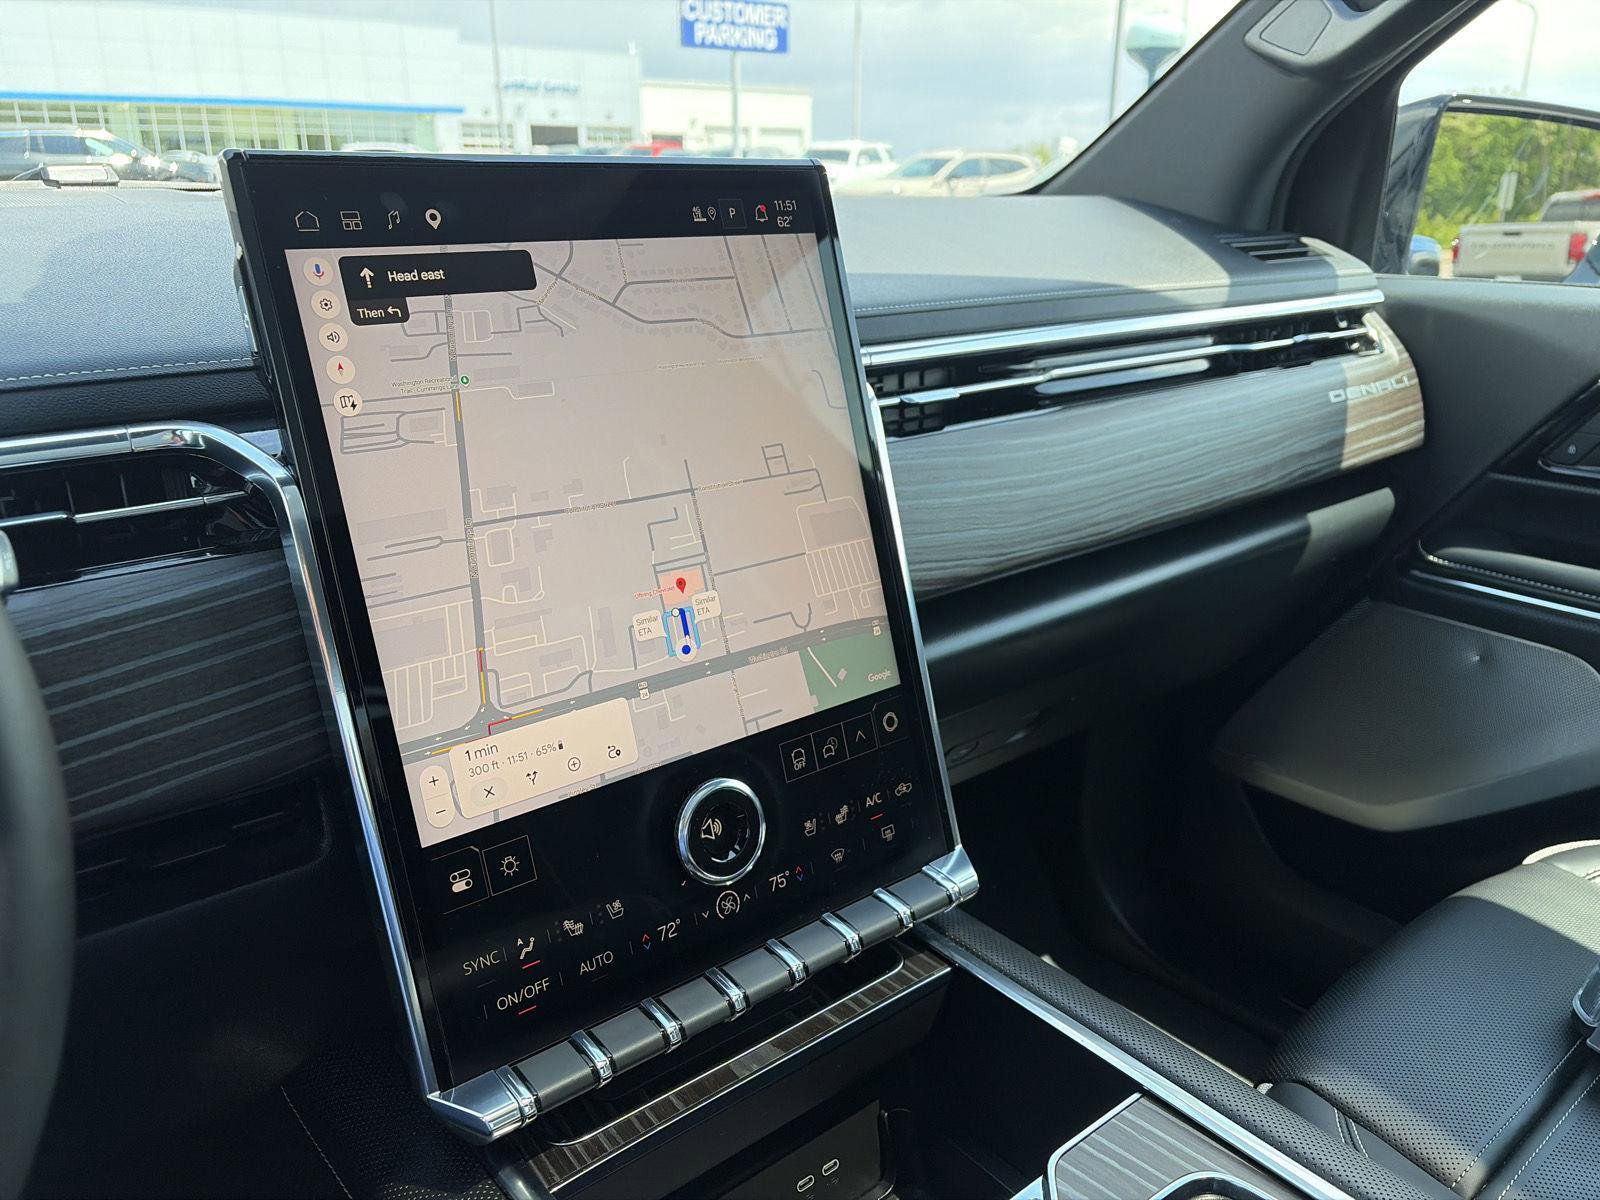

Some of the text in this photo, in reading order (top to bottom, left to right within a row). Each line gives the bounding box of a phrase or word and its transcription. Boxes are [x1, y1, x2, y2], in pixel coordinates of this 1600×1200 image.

[681, 0, 788, 28] CUSTOMER
[694, 21, 778, 50] PARKING
[729, 208, 735, 218] P
[774, 200, 797, 211] 11:51
[777, 216, 792, 227] 62°
[388, 268, 445, 283] Head east
[357, 307, 385, 320] Then
[1328, 375, 1410, 403] DENALI
[695, 595, 716, 606] Similar
[697, 607, 710, 616] ETA
[636, 615, 658, 626] Similar
[638, 627, 653, 637] ETA
[867, 669, 892, 682] Google
[464, 744, 499, 762] 1 min
[468, 743, 557, 778] 300 ft 11:51 65%
[793, 761, 806, 770] OFF
[865, 792, 882, 807] A/C
[769, 870, 790, 892] 75°
[656, 918, 681, 942] 72°
[462, 950, 500, 976] SYNC
[579, 951, 614, 976] AUTO
[496, 977, 551, 1011] ON/OFF
